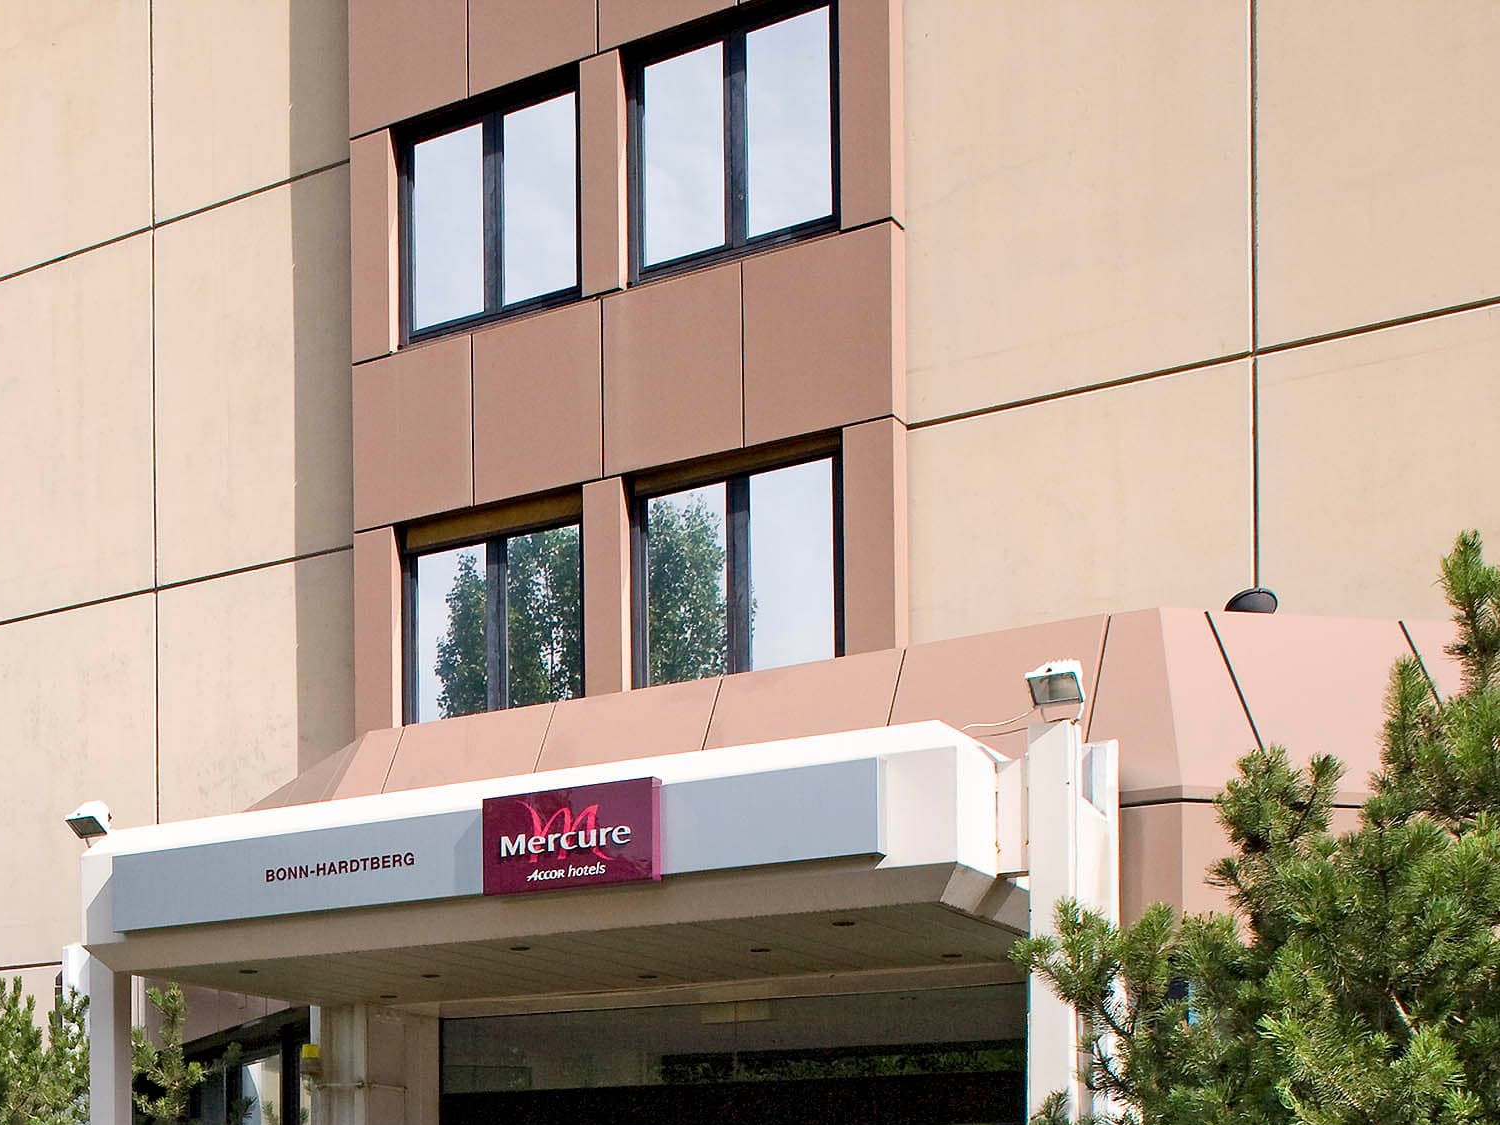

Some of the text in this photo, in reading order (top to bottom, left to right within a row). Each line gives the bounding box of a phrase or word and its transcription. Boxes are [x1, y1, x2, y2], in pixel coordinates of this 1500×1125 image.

[500, 823, 631, 858] Mercure
[265, 852, 415, 883] BONN-HARDTBERG
[567, 862, 606, 878] hotels
